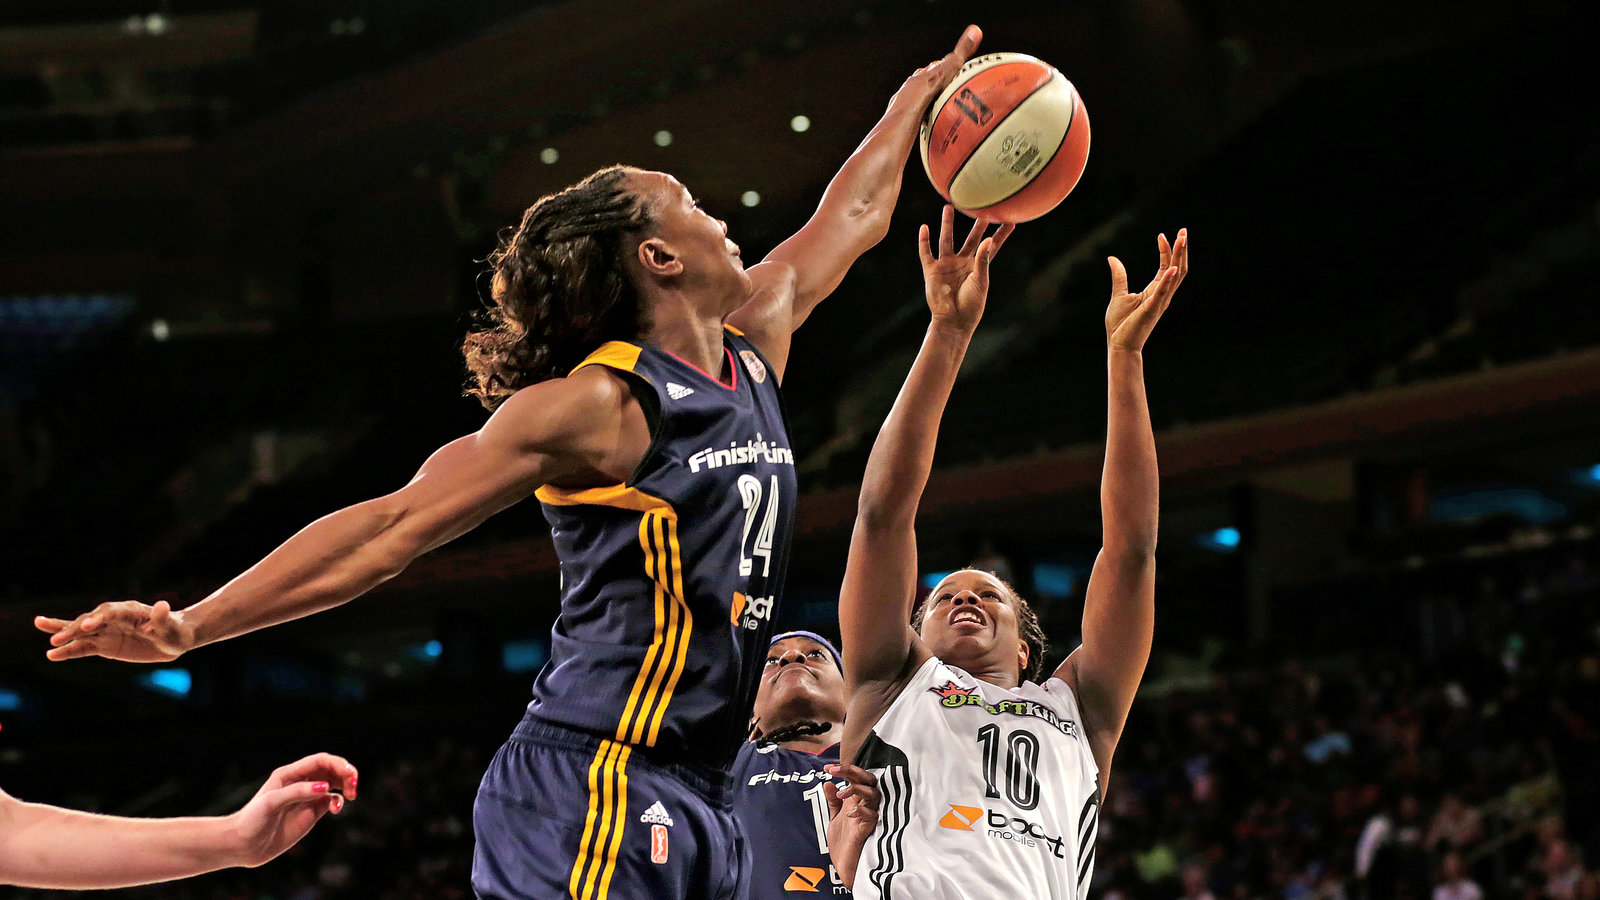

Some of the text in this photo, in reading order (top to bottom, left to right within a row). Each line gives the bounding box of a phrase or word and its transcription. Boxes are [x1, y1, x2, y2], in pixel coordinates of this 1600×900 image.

[737, 474, 779, 577] 24
[977, 723, 1041, 811] 10
[987, 829, 1036, 848] mobile
